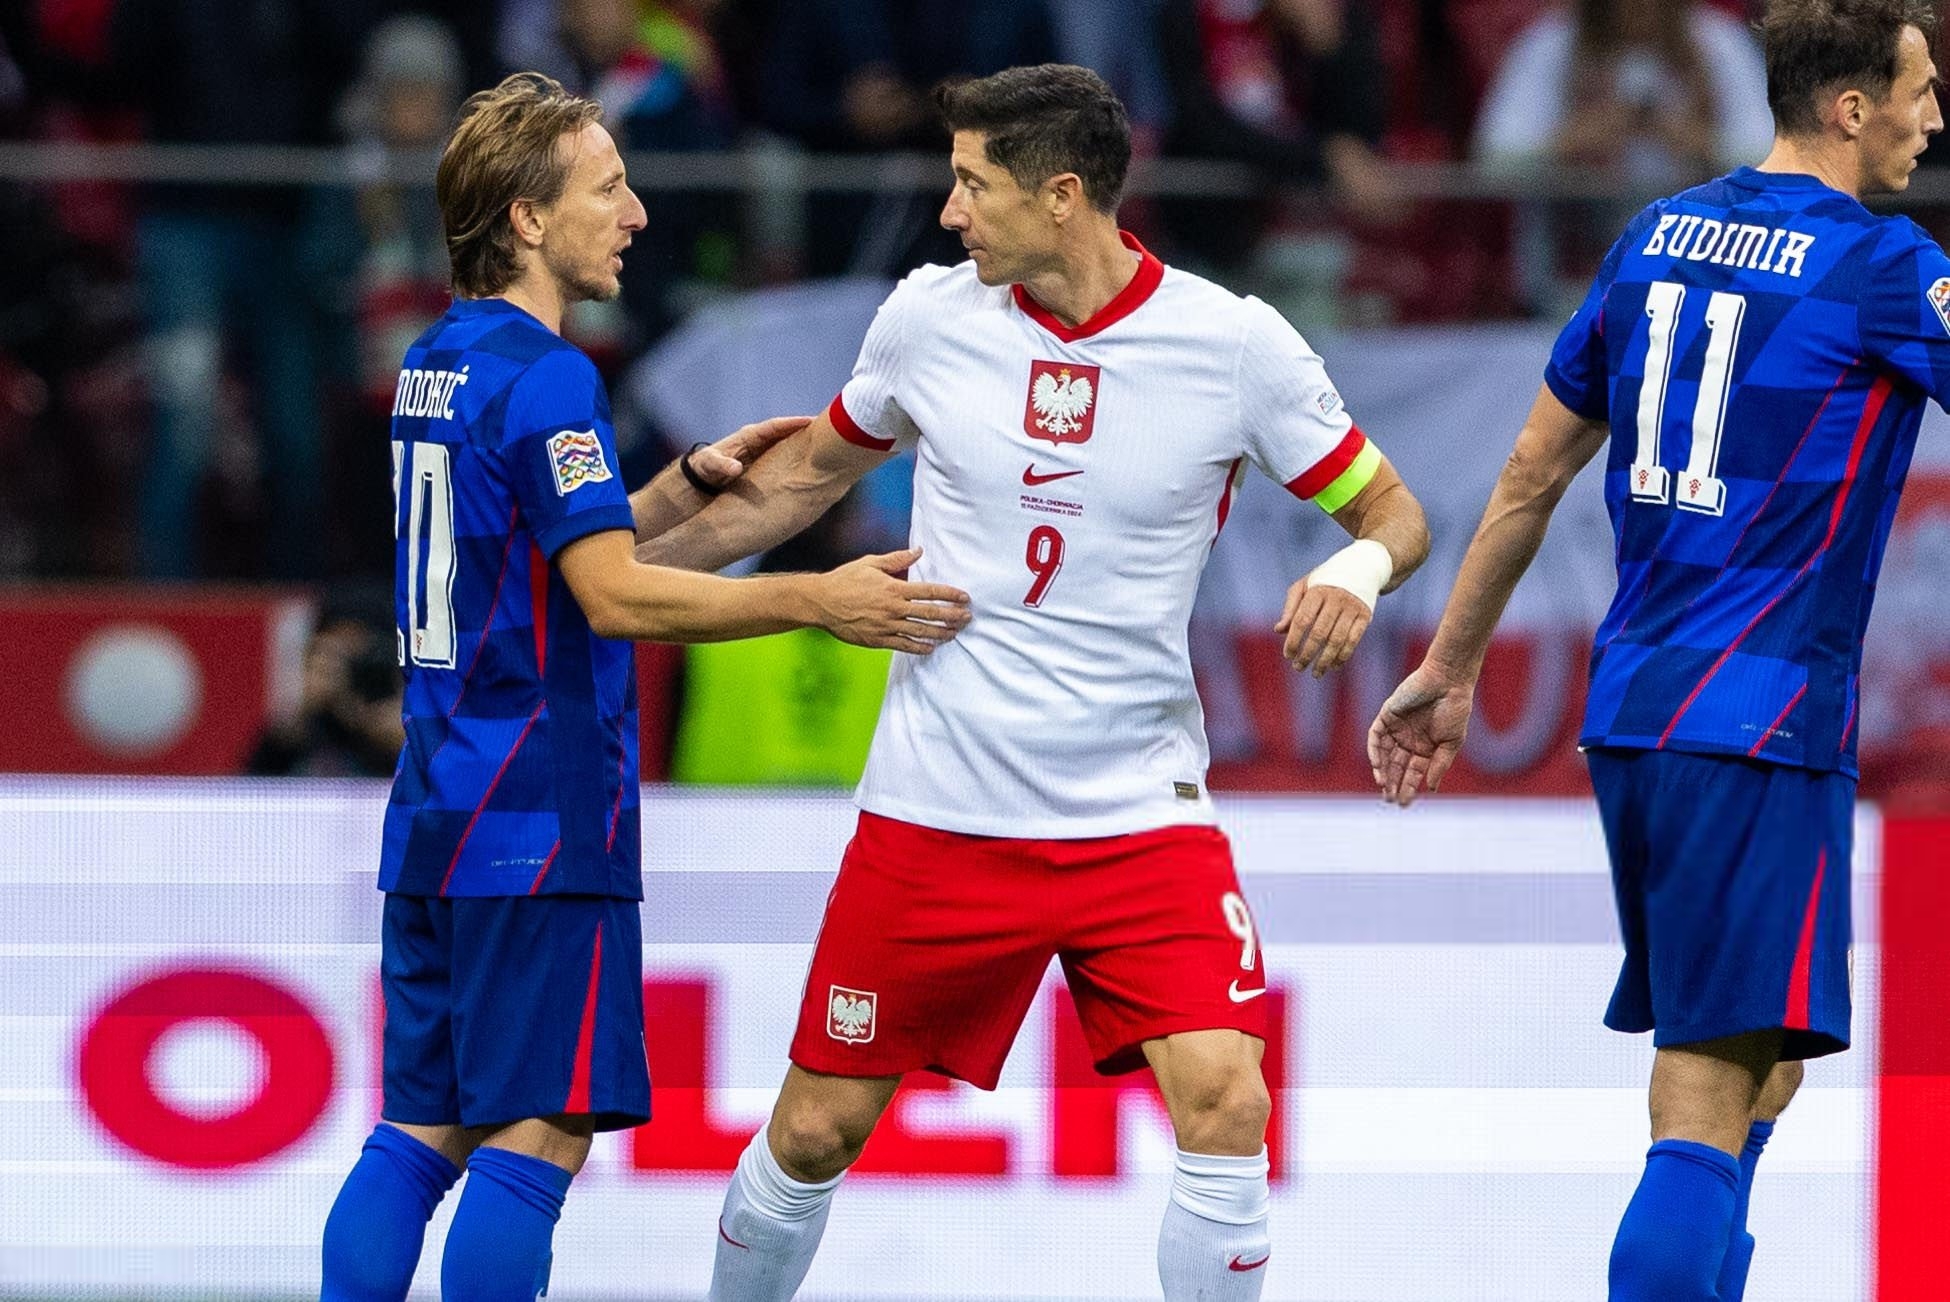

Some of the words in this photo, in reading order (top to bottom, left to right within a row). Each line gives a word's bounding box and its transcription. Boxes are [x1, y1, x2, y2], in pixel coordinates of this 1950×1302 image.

[1642, 214, 1816, 278] BUDIMIR
[1630, 281, 1747, 517] 11
[1023, 525, 1066, 608] 9
[1222, 891, 1256, 972] 9
